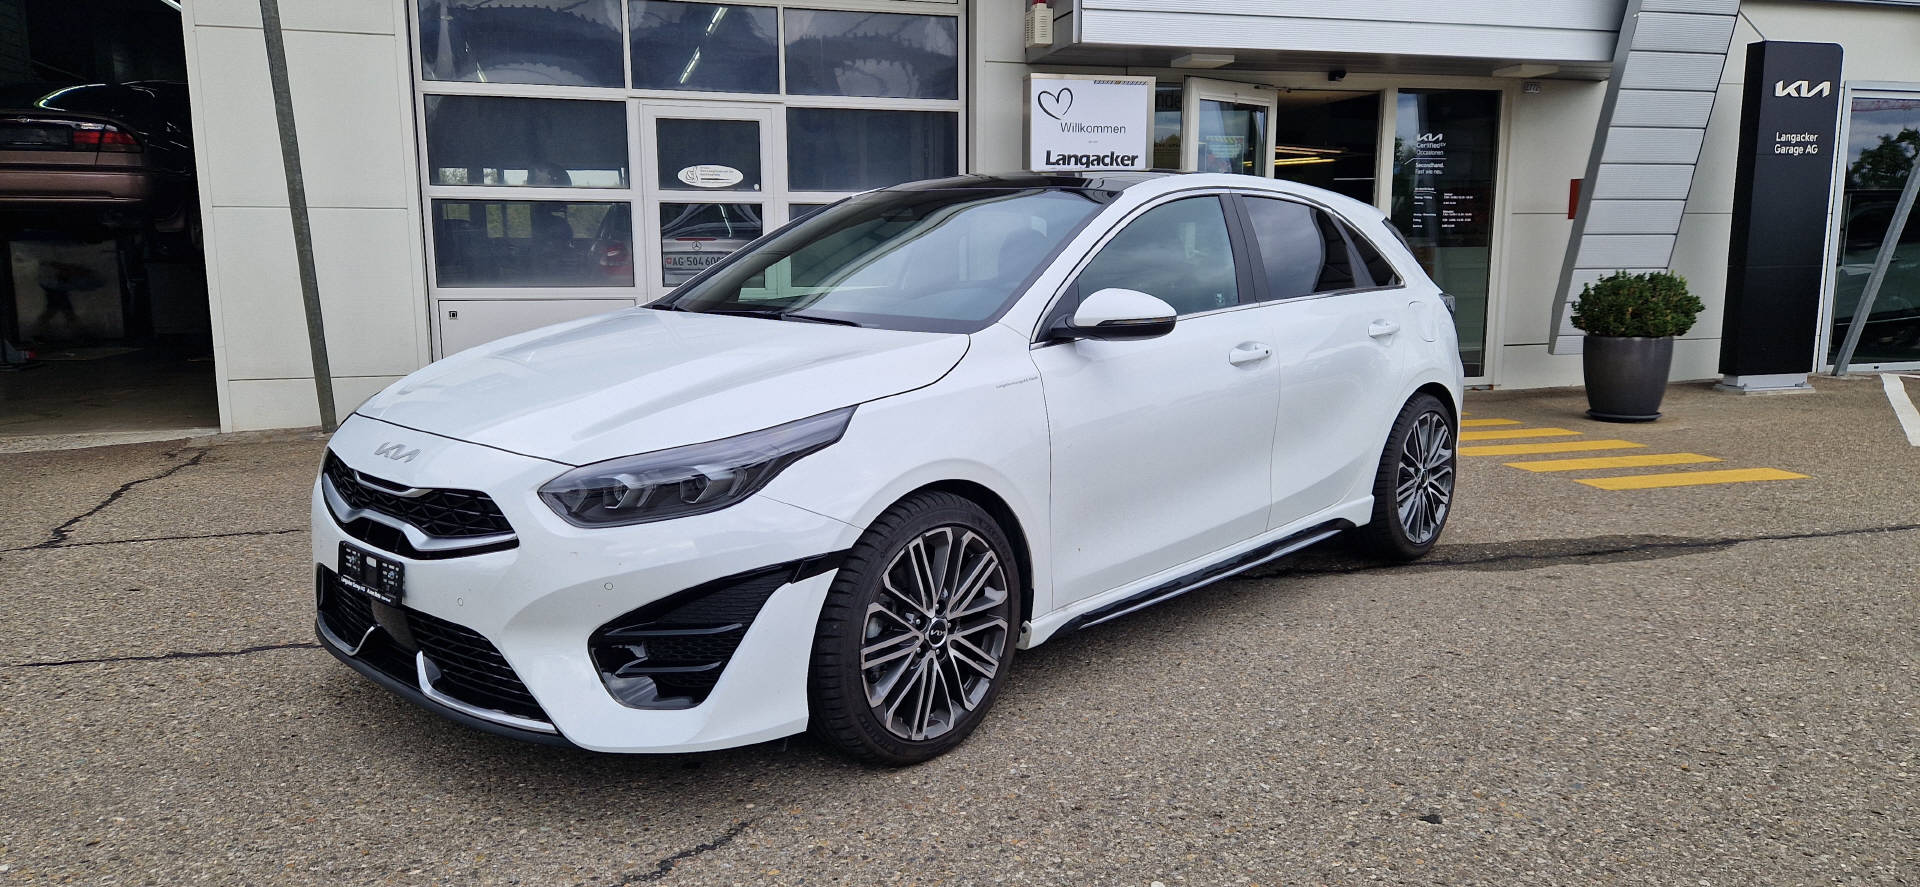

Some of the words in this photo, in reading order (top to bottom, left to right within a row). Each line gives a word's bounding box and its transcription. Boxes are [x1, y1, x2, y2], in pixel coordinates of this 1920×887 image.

[1060, 122, 1126, 134] Willkommen
[1776, 131, 1818, 143] Langacker
[1774, 143, 1803, 156] Garage
[1805, 144, 1818, 154] AG
[1045, 150, 1139, 168] Langacker
[672, 257, 684, 266] AG
[686, 257, 704, 266] 504
